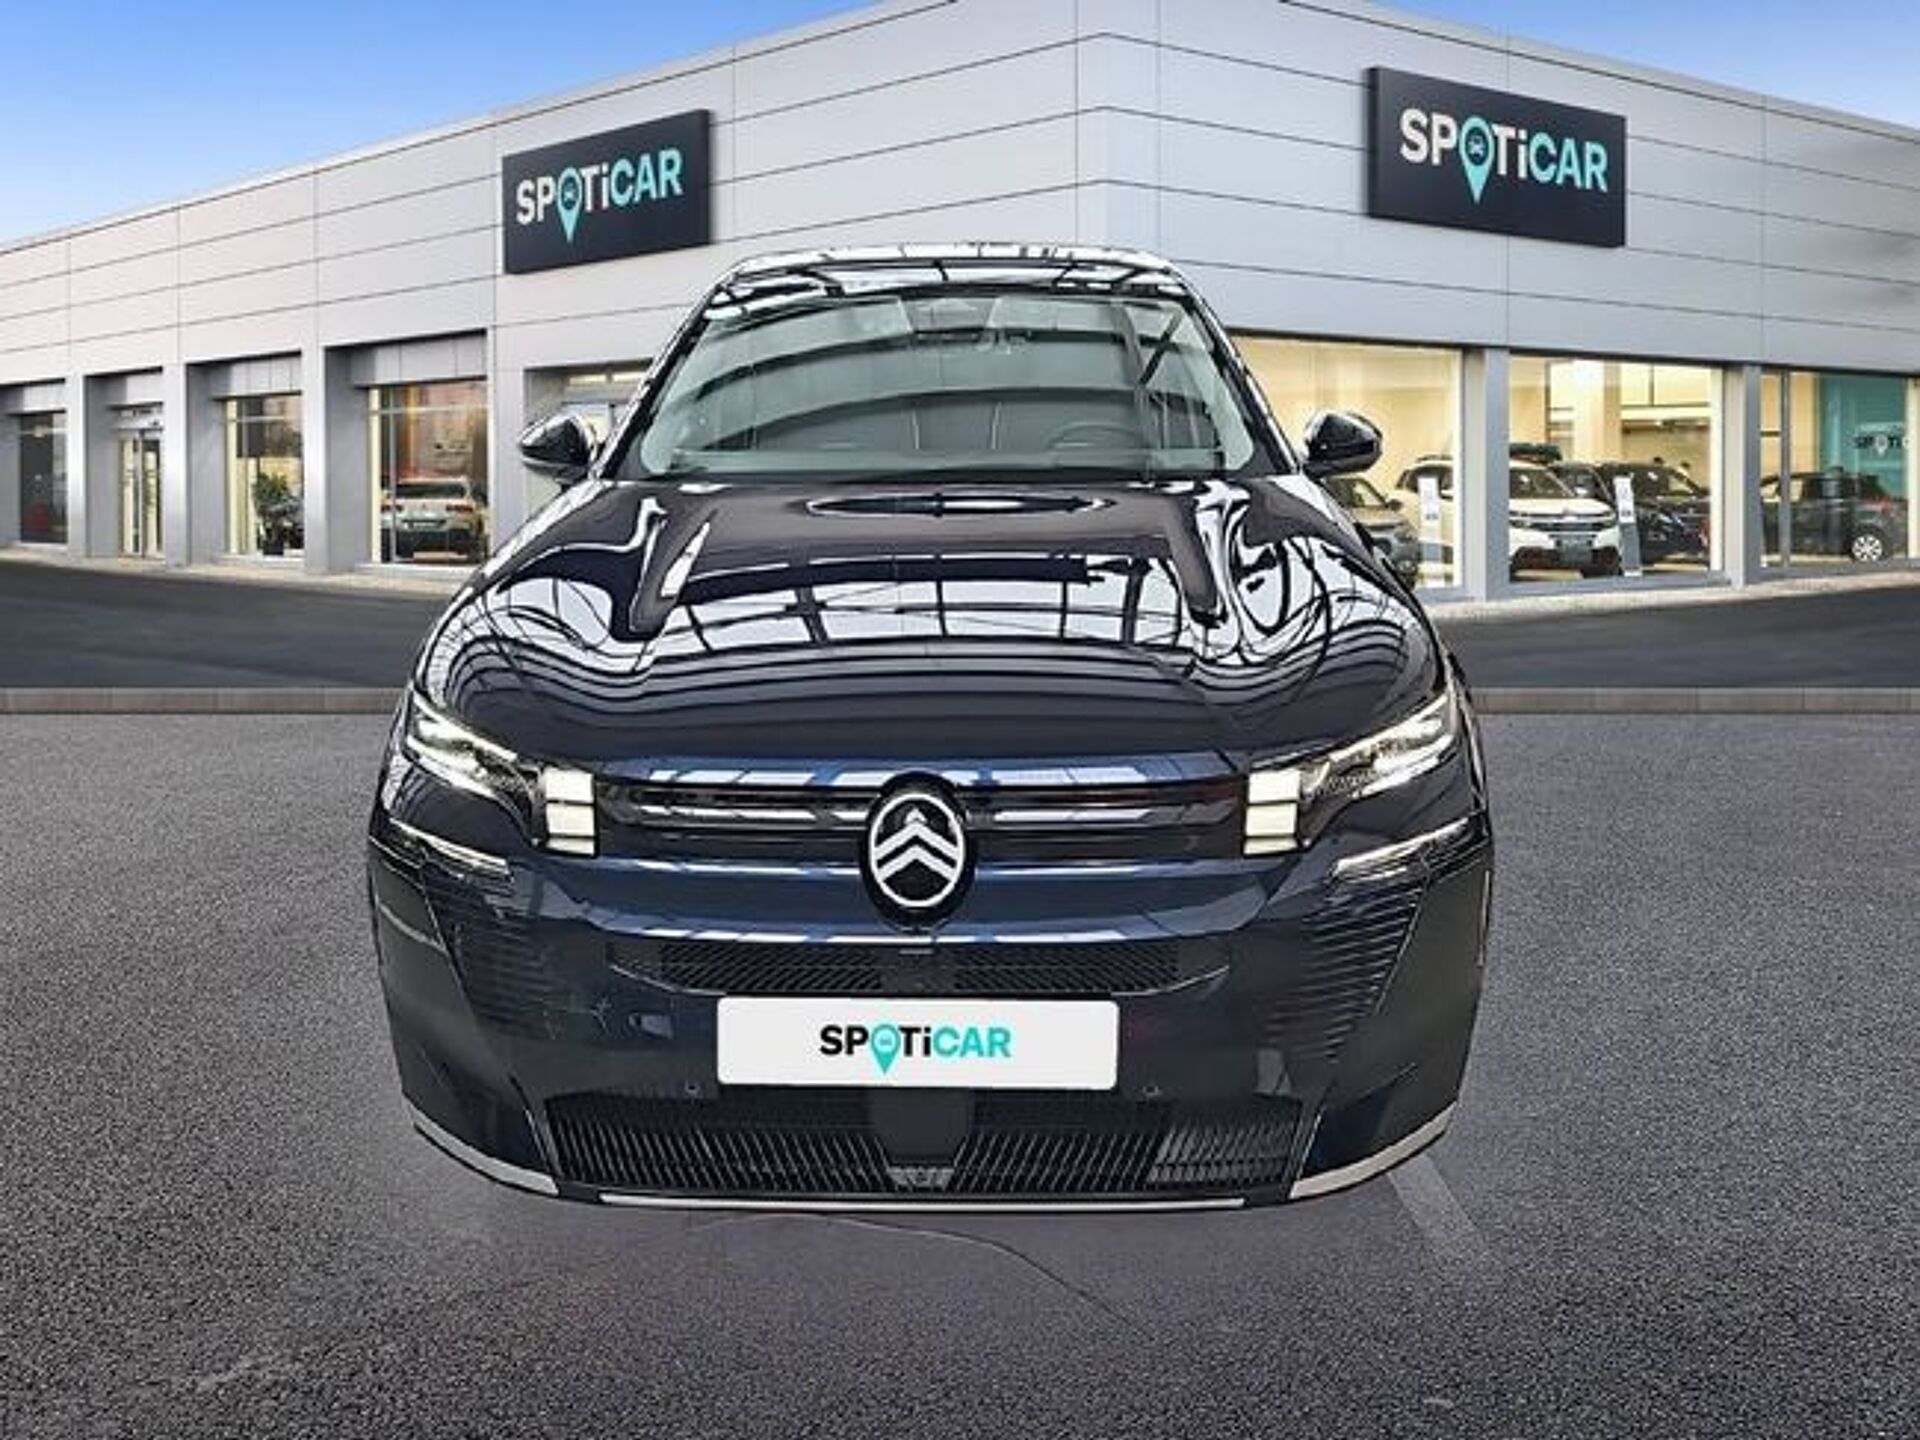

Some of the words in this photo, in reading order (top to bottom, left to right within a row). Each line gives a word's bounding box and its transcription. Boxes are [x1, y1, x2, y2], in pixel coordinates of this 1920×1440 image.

[516, 148, 684, 243] SPOTiCAR
[1400, 107, 1608, 204] SPOTiCAR
[819, 1024, 1012, 1074] SPOTiCAR
